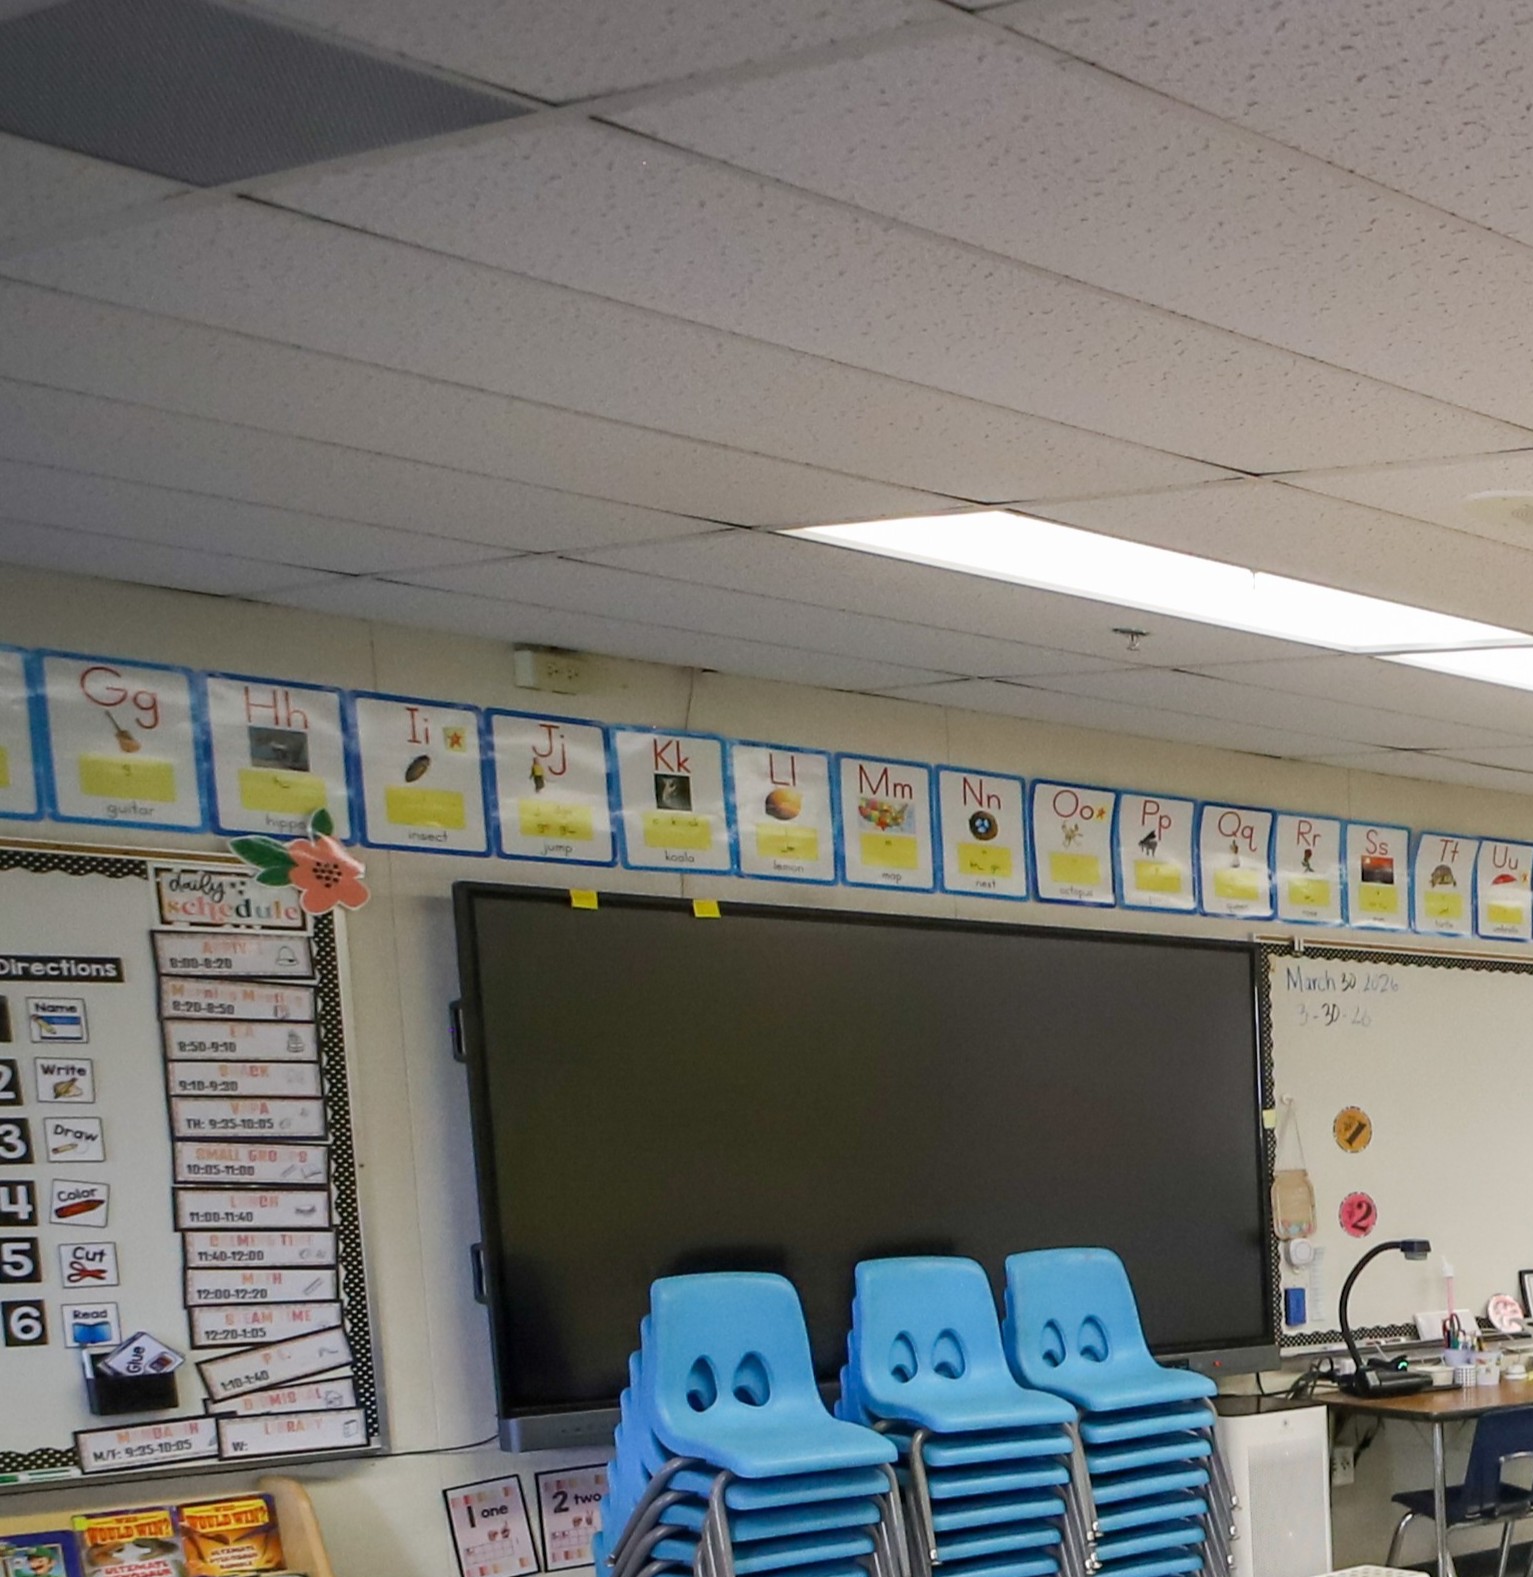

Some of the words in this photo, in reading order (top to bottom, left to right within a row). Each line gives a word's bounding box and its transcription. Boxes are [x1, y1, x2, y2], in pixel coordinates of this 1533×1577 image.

[80, 665, 160, 729] Gg
[243, 686, 309, 730] Hh
[405, 707, 430, 745] Ii
[532, 724, 568, 777] Jj
[653, 738, 692, 774] Kk
[768, 753, 797, 788] Ll
[857, 764, 914, 801] Mm
[961, 776, 1002, 811] Nn
[1052, 789, 1095, 822] Oo
[106, 803, 156, 819] guitar
[1140, 799, 1173, 842] Pp
[407, 829, 449, 845] insect
[1217, 810, 1259, 853] Qq
[1296, 820, 1321, 849] Rr
[1365, 829, 1390, 857] Ss
[540, 840, 574, 857] jump
[664, 849, 696, 865] koala
[1438, 838, 1460, 865] Tt
[1491, 846, 1520, 872] Uu
[773, 859, 805, 875] lemon
[881, 871, 903, 884] map
[168, 872, 227, 904] daily
[974, 878, 997, 891] nest
[164, 896, 300, 923] schedule
[1286, 966, 1336, 993] March
[33, 1001, 78, 1015] Name
[40, 1063, 88, 1078] Write
[0, 1123, 28, 1160] 3
[52, 1123, 99, 1143] Draw
[0, 1186, 34, 1221] 4
[56, 1186, 99, 1202] Color
[188, 1211, 254, 1223] 11:00-11:40
[1350, 1199, 1375, 1233] 2
[1, 1242, 35, 1278] 5
[71, 1246, 108, 1265] Cut
[197, 1250, 265, 1262] 11:40-12:00
[196, 1288, 268, 1300] 12:00-12:20
[9, 1305, 44, 1342] 6
[71, 1309, 109, 1321] Read
[125, 1344, 147, 1375] Glue
[480, 1504, 509, 1520] one
[551, 1490, 570, 1514] 2
[573, 1492, 602, 1505] two
